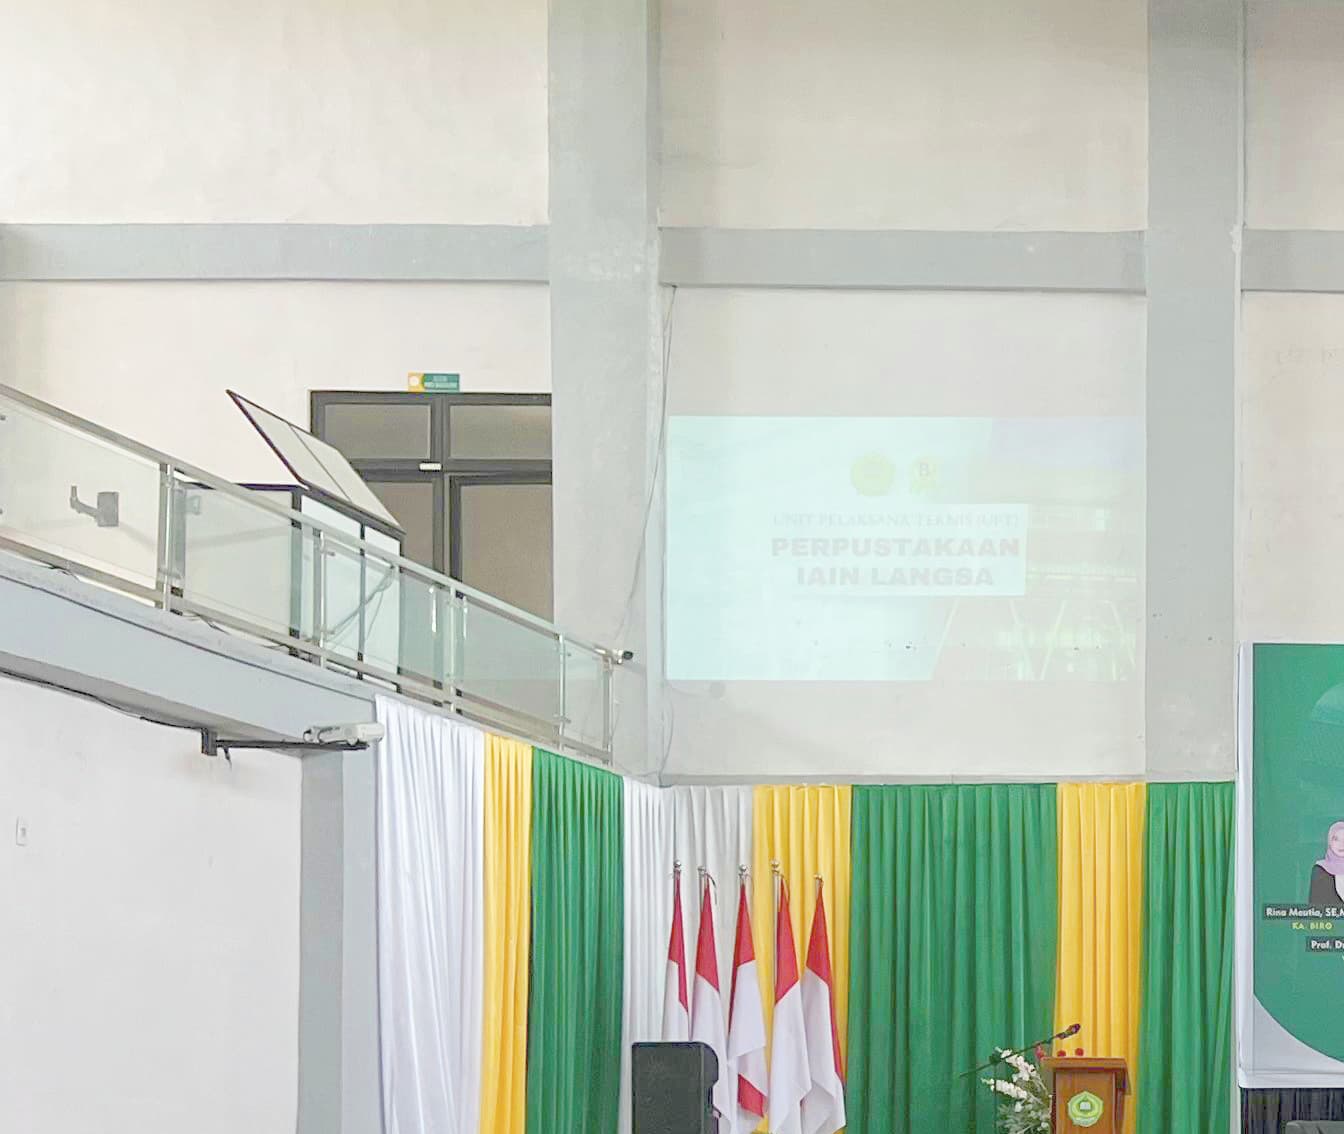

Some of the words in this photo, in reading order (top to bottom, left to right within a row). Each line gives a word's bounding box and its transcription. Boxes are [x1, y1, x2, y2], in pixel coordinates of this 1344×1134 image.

[770, 537, 1020, 558] PERPUSTAKAAN
[797, 567, 860, 586] IAIN
[870, 567, 994, 586] LANGSA
[1266, 907, 1287, 917] Rina
[1310, 922, 1333, 931] BIRO
